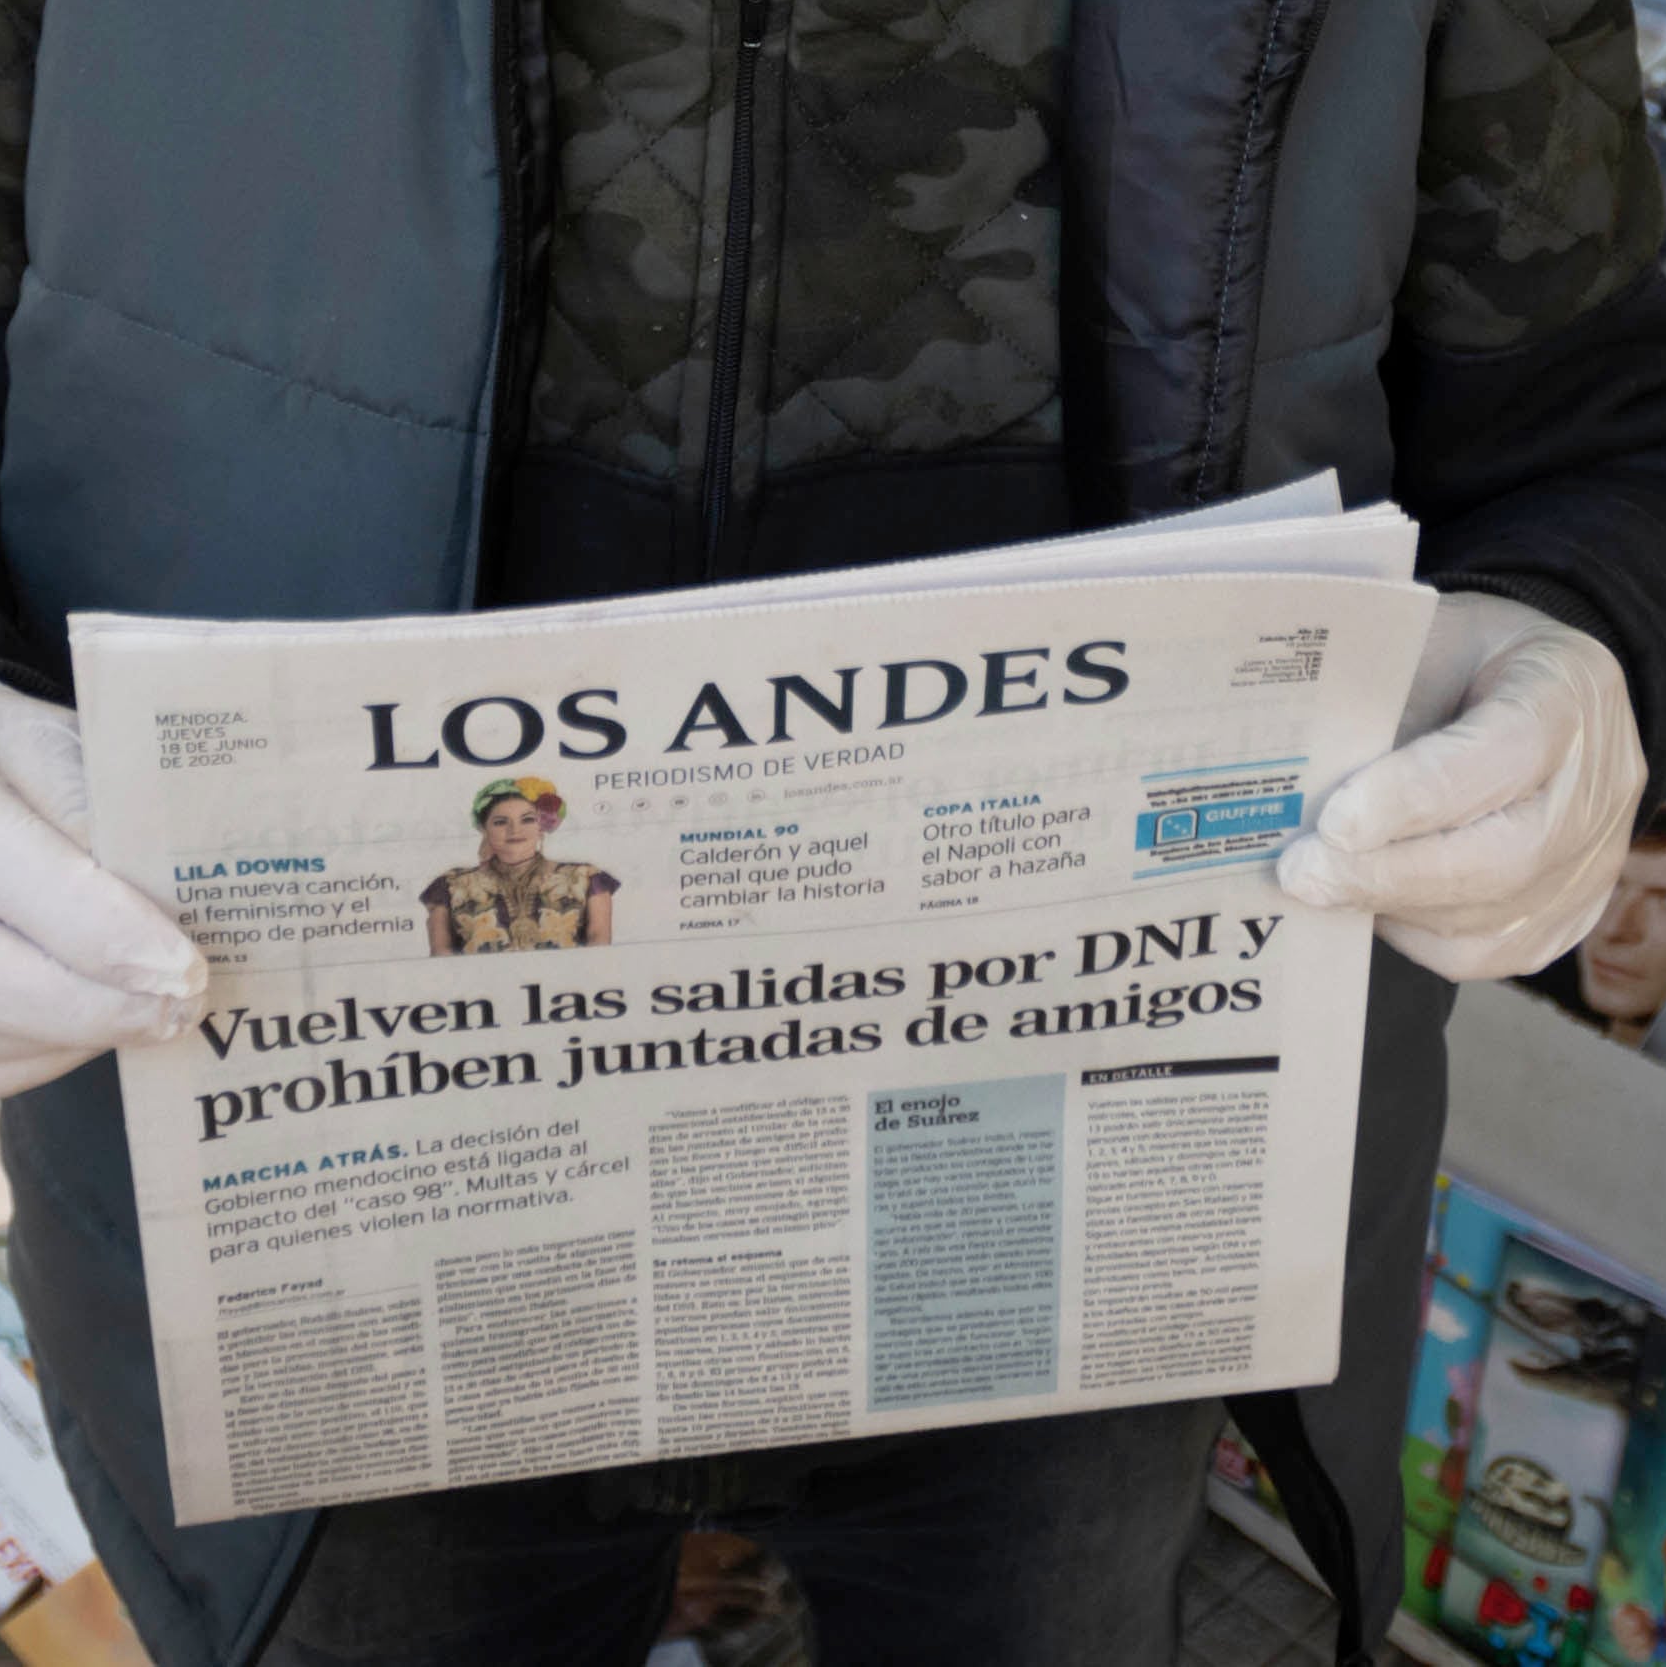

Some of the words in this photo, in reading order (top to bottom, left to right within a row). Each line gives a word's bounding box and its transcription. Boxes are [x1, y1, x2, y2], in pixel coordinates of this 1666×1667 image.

[361, 687, 629, 771] LOS
[663, 639, 1130, 753] ANDES
[157, 726, 227, 742] JUEVES
[160, 742, 181, 755] 18
[184, 740, 209, 754] DE
[213, 736, 268, 752] JUNIO
[159, 755, 181, 770] DE
[593, 760, 754, 791] PERIODISMO
[763, 755, 796, 777] DE
[803, 742, 906, 772] VERDAD
[783, 774, 904, 800] losandes.com.ar
[922, 801, 974, 819] COPA
[980, 793, 1042, 813] ITALIA
[679, 827, 767, 844] MUNDIAL
[773, 823, 800, 838] 90
[922, 821, 974, 843] Otro
[979, 814, 1036, 836] título
[1040, 805, 1092, 829] para
[679, 842, 782, 866] Calderón
[787, 845, 803, 862] y
[807, 832, 869, 857] aquel
[921, 848, 941, 866] el
[947, 839, 1016, 863] Napoli
[1021, 833, 1062, 852] con
[174, 862, 229, 883] LILA
[235, 857, 326, 878] DOWNS
[679, 868, 741, 890] penal
[746, 868, 790, 887] que
[795, 860, 853, 882] pudo
[921, 864, 982, 889] sabor
[988, 863, 1002, 880] a
[1008, 850, 1087, 878] hazaña
[175, 884, 223, 904] Una
[229, 880, 300, 900] nueva
[304, 872, 401, 898] canción,
[678, 888, 770, 910] cambiar
[776, 885, 796, 902] la
[802, 877, 886, 901] historia
[179, 908, 199, 926] el
[205, 900, 326, 923] feminismo
[331, 904, 346, 920] y
[350, 896, 371, 914] el
[186, 926, 261, 948] iempo
[267, 920, 297, 942] de
[301, 915, 415, 944] pandemia
[197, 996, 500, 1063] Vuelven
[520, 983, 629, 1027] las
[649, 962, 907, 1021] salidas
[925, 948, 1057, 1001] por
[1072, 912, 1223, 979] DNI
[1238, 912, 1285, 961] y
[194, 1048, 544, 1143] prohíben
[556, 1020, 884, 1089] juntadas
[904, 1005, 990, 1048] de
[1007, 976, 1264, 1038] amigos
[1089, 1072, 1109, 1084] EN
[1114, 1065, 1174, 1081] DETALLE
[874, 1098, 894, 1116] El
[899, 1093, 963, 1116] enojo
[874, 1115, 901, 1132] de
[906, 1110, 981, 1130] Suárez
[202, 1158, 310, 1194] MARCHA
[317, 1142, 410, 1172] ATRÁS.
[415, 1137, 444, 1157] La
[448, 1122, 542, 1153] decisión
[547, 1119, 581, 1139] del
[203, 1183, 309, 1216] Gobierno
[313, 1160, 439, 1196] mendocino
[442, 1153, 491, 1176] está
[496, 1142, 564, 1174] ligada
[568, 1139, 590, 1159] al
[206, 1208, 299, 1239] impacto
[304, 1198, 339, 1221] del
[465, 1168, 540, 1196] Multas
[544, 1166, 560, 1186] y
[563, 1155, 630, 1181] cárcel
[208, 1239, 260, 1265] para
[265, 1222, 354, 1253] quienes
[358, 1208, 426, 1235] violen
[430, 1204, 452, 1223] la
[456, 1187, 575, 1217] normativa.
[730, 1248, 783, 1264] esquema
